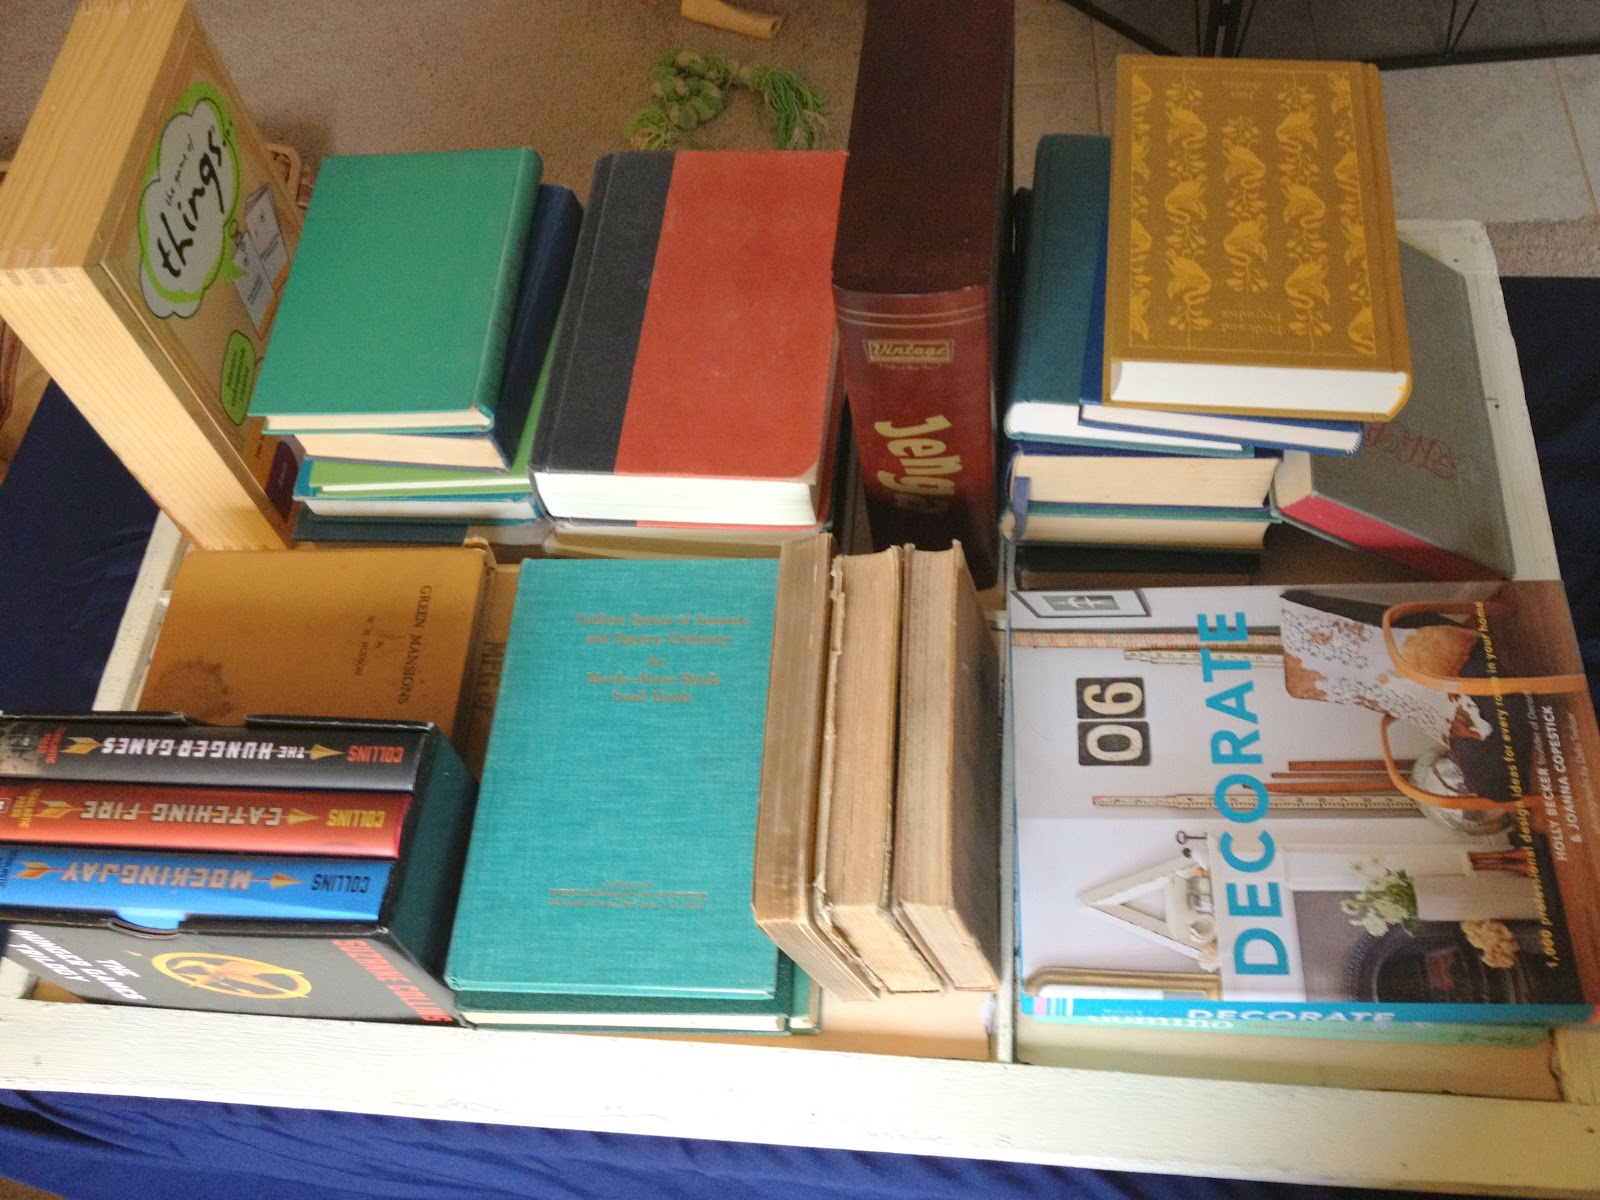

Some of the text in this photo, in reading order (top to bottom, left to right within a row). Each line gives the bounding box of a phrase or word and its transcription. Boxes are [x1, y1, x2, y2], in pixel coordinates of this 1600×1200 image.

[871, 343, 948, 355] Vintage
[1473, 601, 1488, 632] home
[397, 585, 432, 705] GREEN MANSIONS
[1481, 634, 1498, 661] your
[1486, 662, 1497, 674] in
[1497, 709, 1512, 741] every
[101, 737, 405, 764] COLLINS THE HUNGER GAMES
[1503, 745, 1515, 763] for
[1508, 765, 1523, 798] ideas
[1541, 705, 1583, 844] & JOANNA COPESTICK
[1196, 611, 1290, 976] DECORATE
[1536, 767, 1558, 817] BECKER
[80, 800, 386, 828] COLLINS CATCHING FIRE
[1515, 801, 1533, 843] design
[1549, 819, 1568, 862] HOLLY
[61, 862, 371, 893] COLLINS MOCKINGJAY
[1522, 846, 1554, 926] professional
[8, 944, 91, 982] TRILOGY
[8, 929, 148, 1000] HUNGER GAMES
[1540, 929, 1560, 968] 1,000
[95, 959, 141, 978] THE
[332, 939, 453, 1022] SUZANNE COLLINS
[1188, 1009, 1396, 1023] DECORATE
